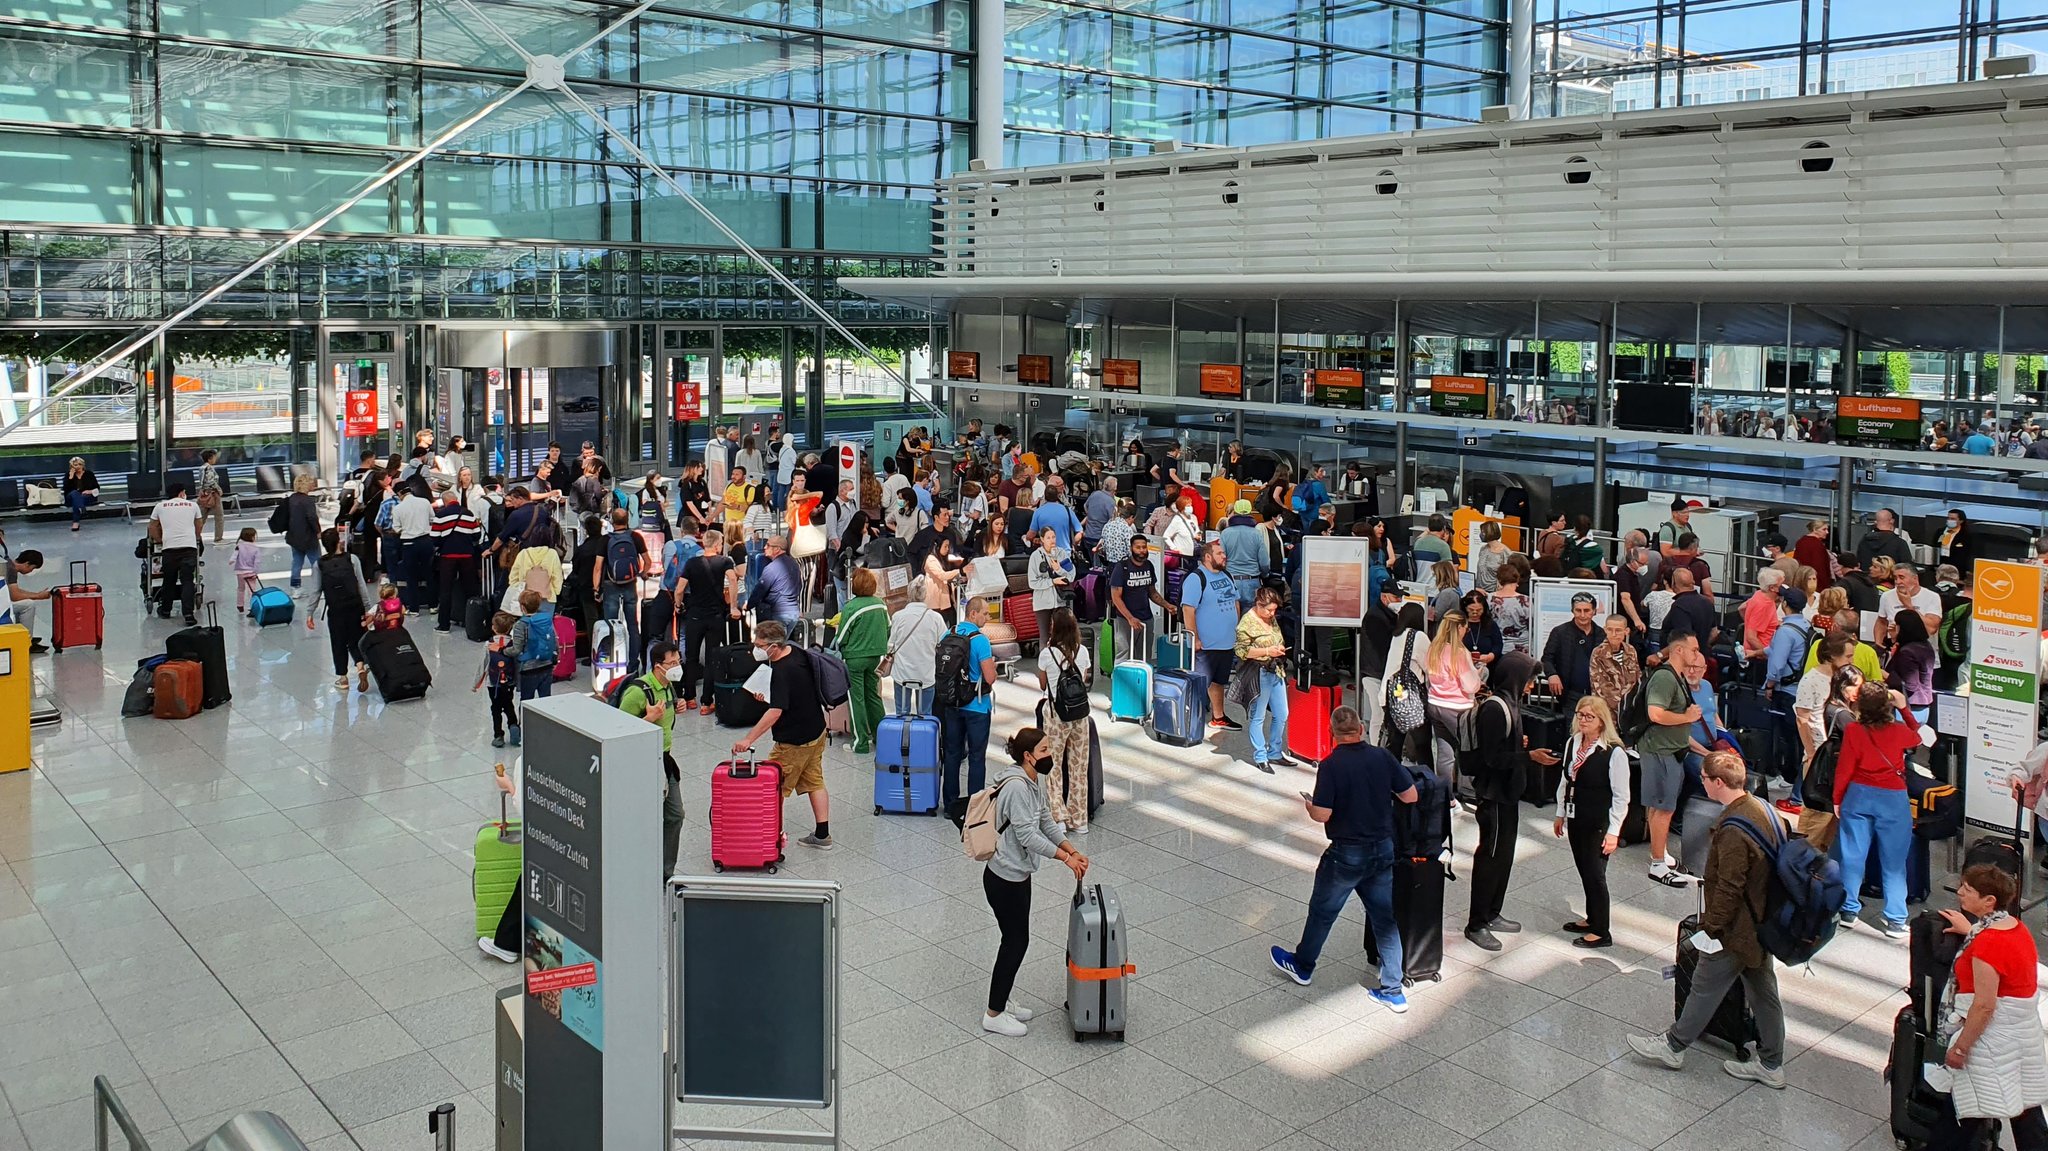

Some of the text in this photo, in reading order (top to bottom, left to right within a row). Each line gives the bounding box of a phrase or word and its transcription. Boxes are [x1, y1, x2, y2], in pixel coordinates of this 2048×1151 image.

[1326, 374, 1353, 382] Lufthansa
[1326, 386, 1349, 394] Economy
[1445, 380, 1475, 390] Lufthansa
[352, 392, 370, 400] STOP
[1444, 394, 1470, 402] Economy
[1858, 403, 1902, 413] Lufthansa
[1857, 419, 1894, 429] Economy
[1857, 426, 1879, 434] Class
[1129, 570, 1151, 580] DALLAS
[1977, 605, 2032, 622] Lufthansa
[1978, 624, 2015, 637] Austrian
[1995, 657, 2024, 668] SWISS
[1975, 669, 2025, 687] Economy
[1975, 680, 2003, 692] Class
[527, 764, 587, 808] Aussichtsterrasse
[527, 786, 585, 830] Observation Deck
[1968, 818, 1984, 827] STAR
[527, 821, 589, 870] kostenloser Zutritt
